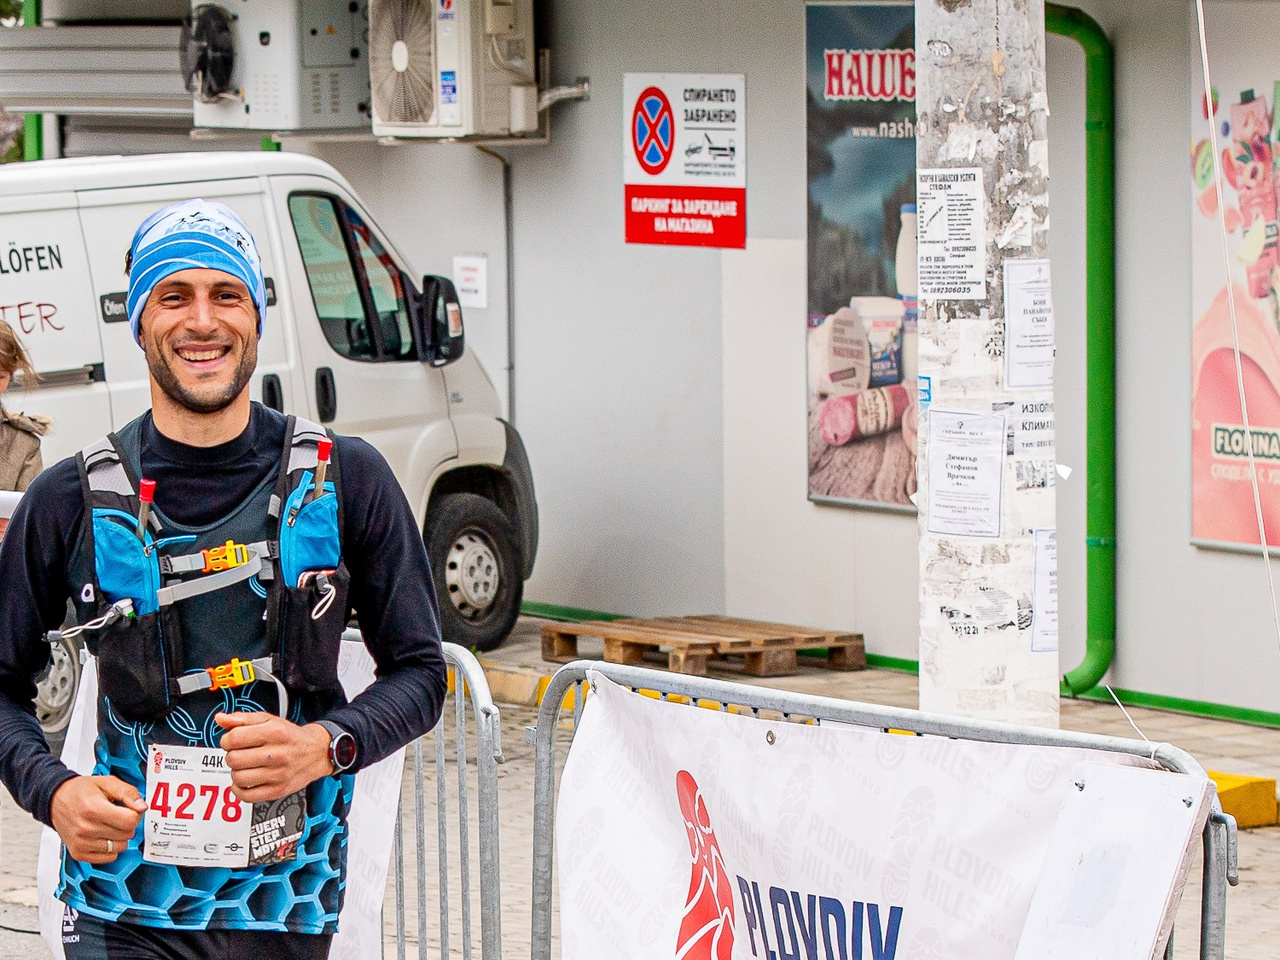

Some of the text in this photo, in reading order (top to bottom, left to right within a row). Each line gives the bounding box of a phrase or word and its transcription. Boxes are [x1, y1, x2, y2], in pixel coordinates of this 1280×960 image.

[824, 48, 916, 102] НАШЕ
[683, 89, 736, 103] СПИРАНЕТО
[683, 109, 736, 123] ЗАБРАНЕНО
[851, 117, 917, 138] www.nash
[671, 198, 683, 213] ЗА
[654, 217, 714, 234] НА МАГАЗИНА
[946, 454, 977, 462] Димитър
[945, 462, 978, 471] Стефанов
[201, 754, 224, 769] 44K
[150, 781, 243, 823] 4278
[251, 829, 280, 848] STEP
